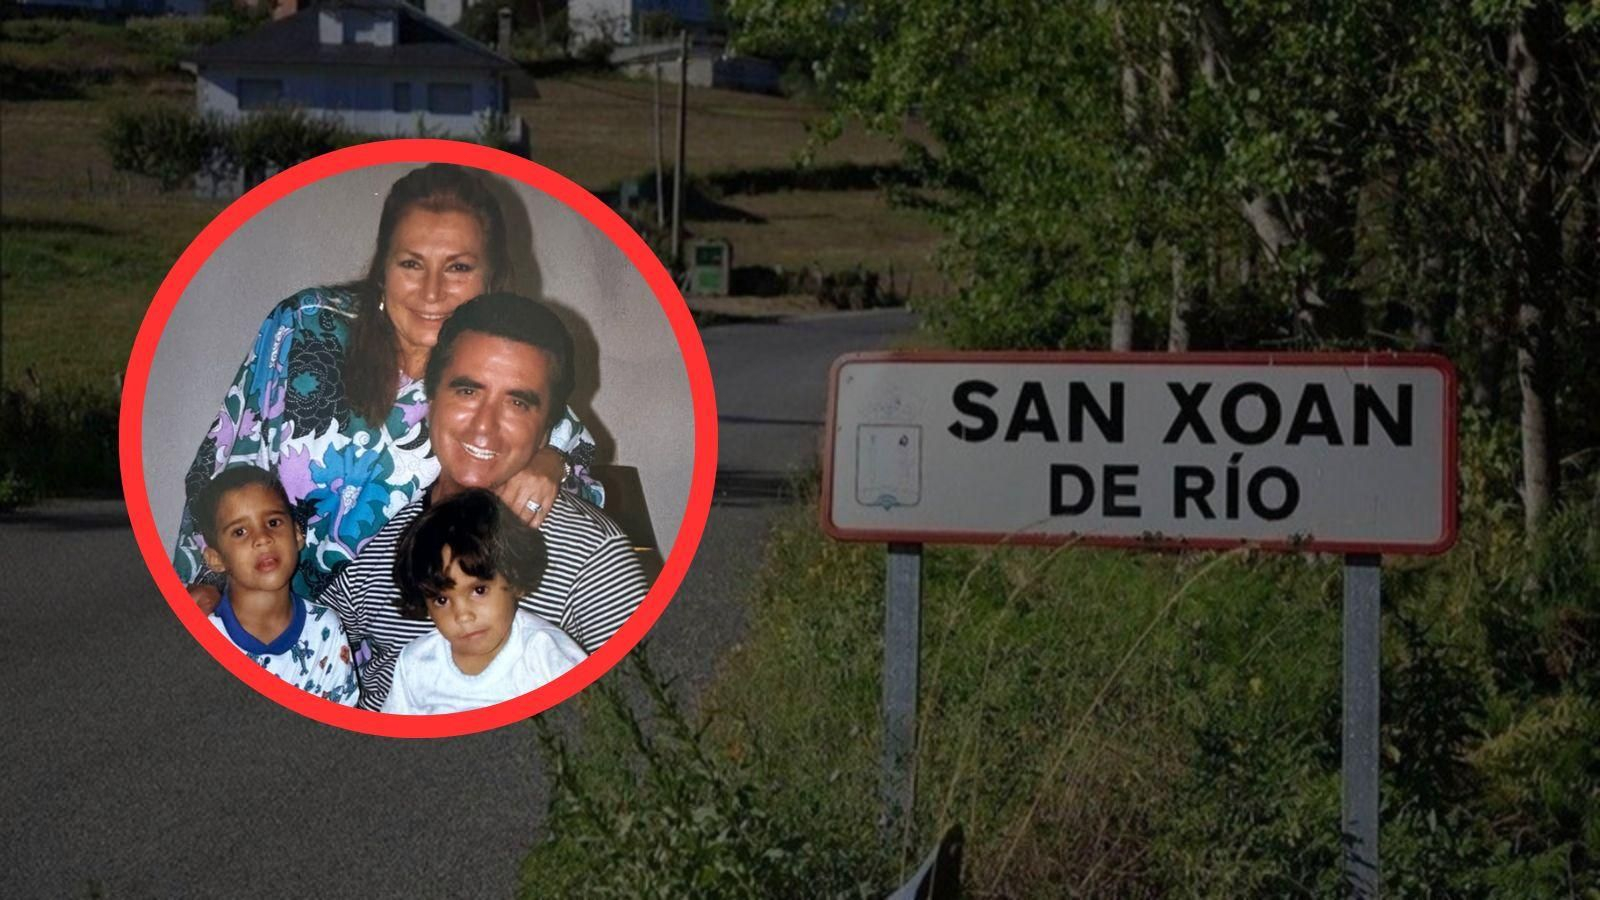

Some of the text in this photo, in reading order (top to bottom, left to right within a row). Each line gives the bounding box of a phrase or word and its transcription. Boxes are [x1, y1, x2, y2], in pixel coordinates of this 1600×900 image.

[948, 380, 1414, 447] SAN XOAN
[1049, 453, 1300, 521] DE RÍO
